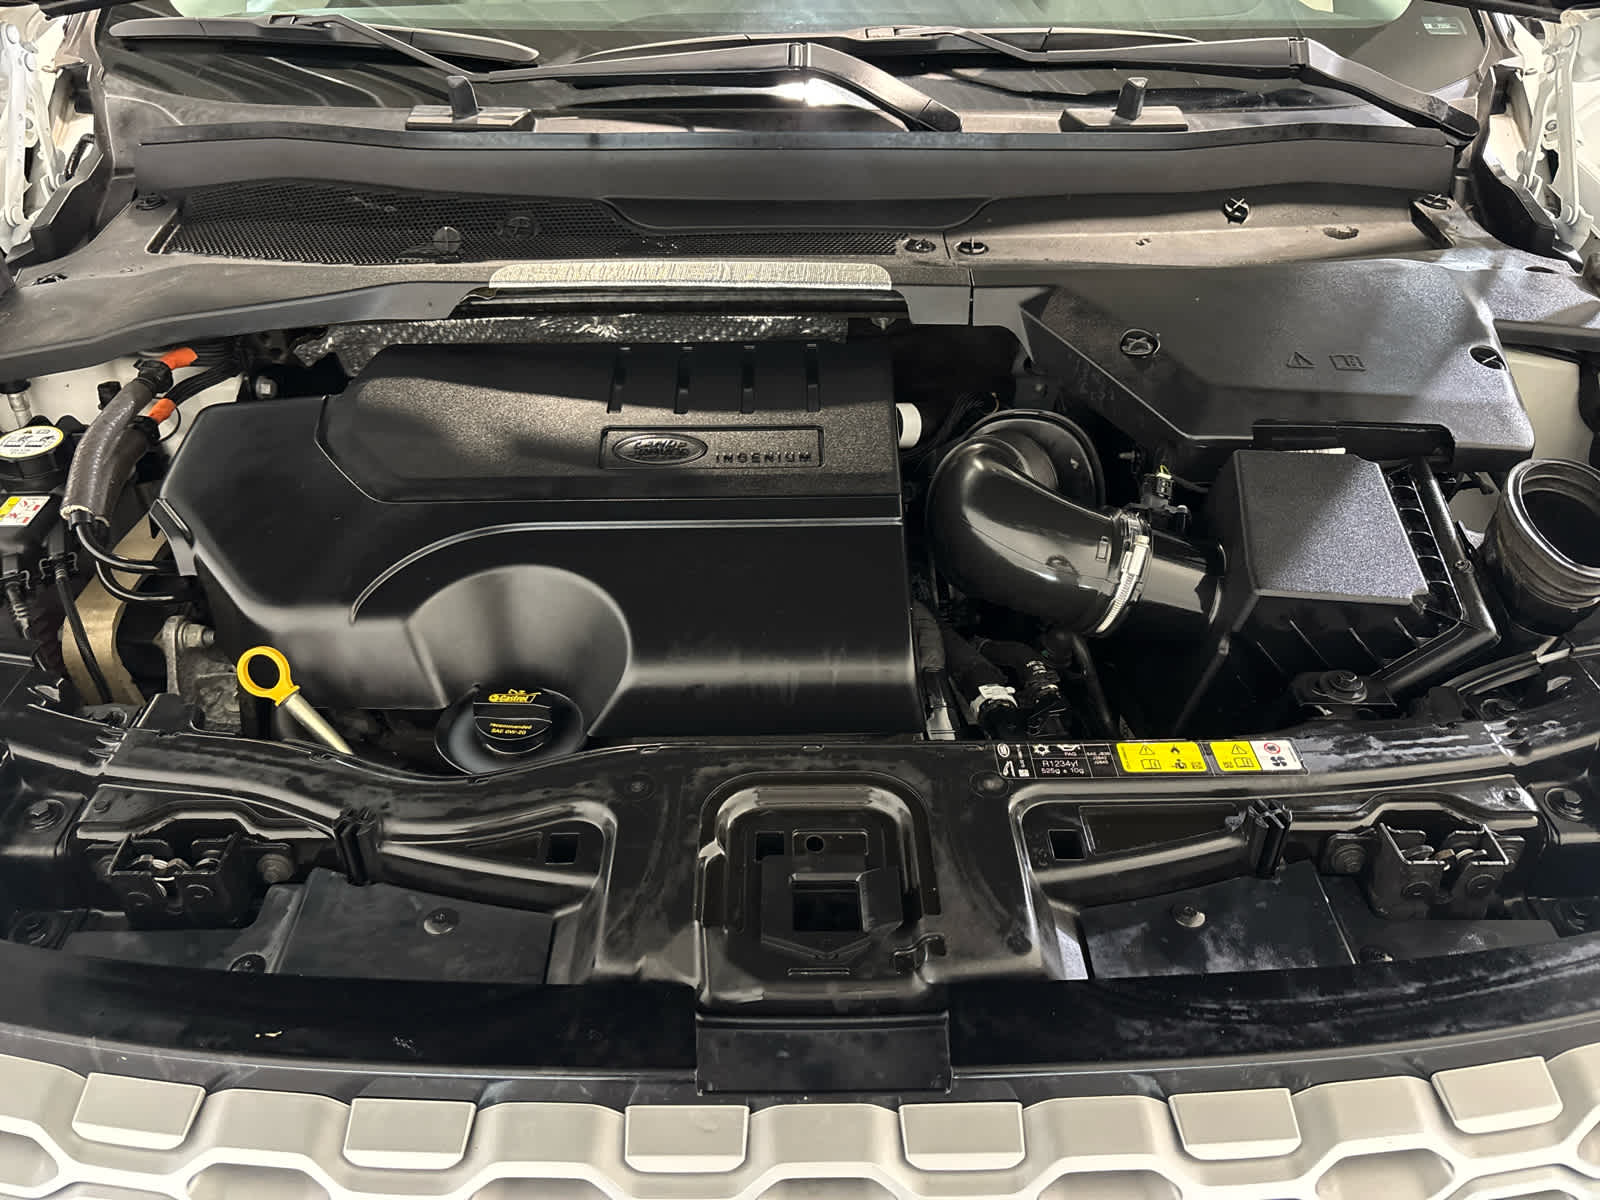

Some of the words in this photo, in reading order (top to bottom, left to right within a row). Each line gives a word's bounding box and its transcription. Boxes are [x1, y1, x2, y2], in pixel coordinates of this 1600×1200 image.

[714, 452, 813, 464] INGENIUM
[499, 694, 529, 703] Castrol
[489, 722, 533, 730] recommended
[1042, 759, 1079, 768] R1234yf
[1070, 767, 1085, 775] 10g
